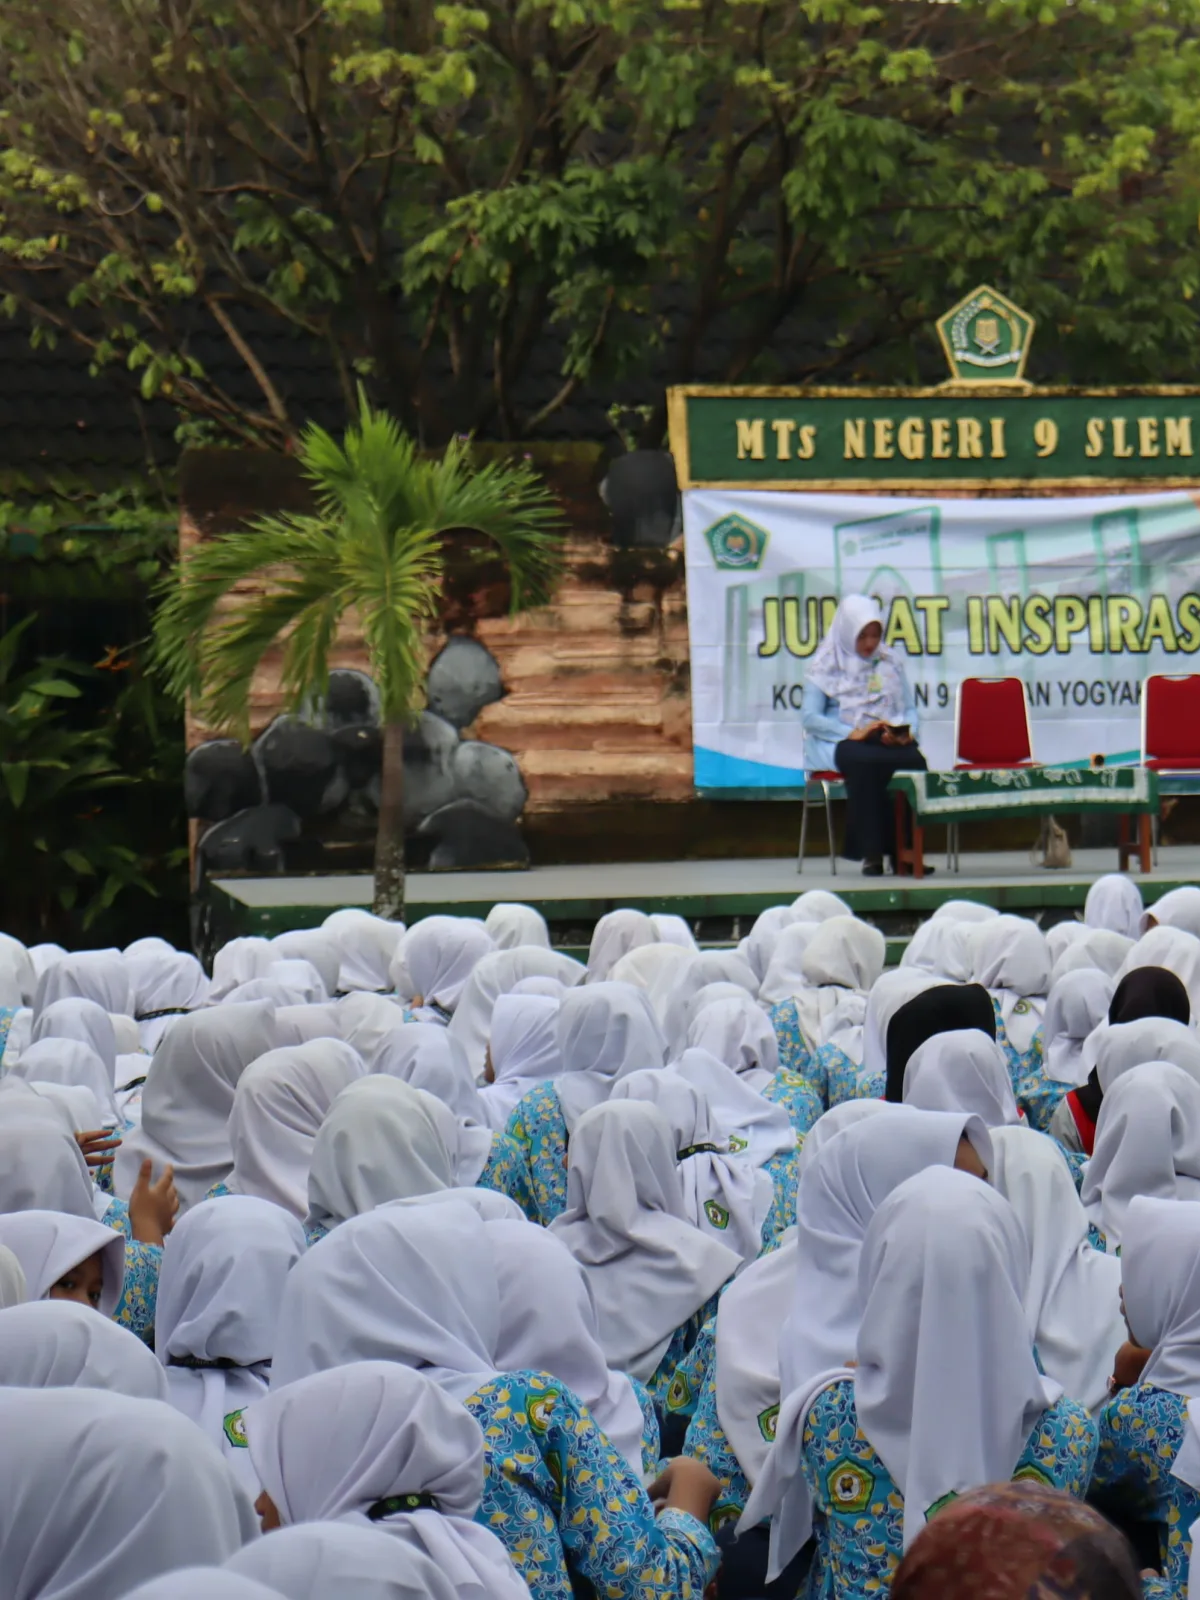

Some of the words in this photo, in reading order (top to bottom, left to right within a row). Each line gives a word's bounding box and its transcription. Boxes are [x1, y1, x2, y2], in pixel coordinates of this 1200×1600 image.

[736, 417, 816, 460] MTs
[843, 416, 1007, 460] NEGERI
[1034, 417, 1059, 458] 9
[758, 596, 949, 658] JUAT
